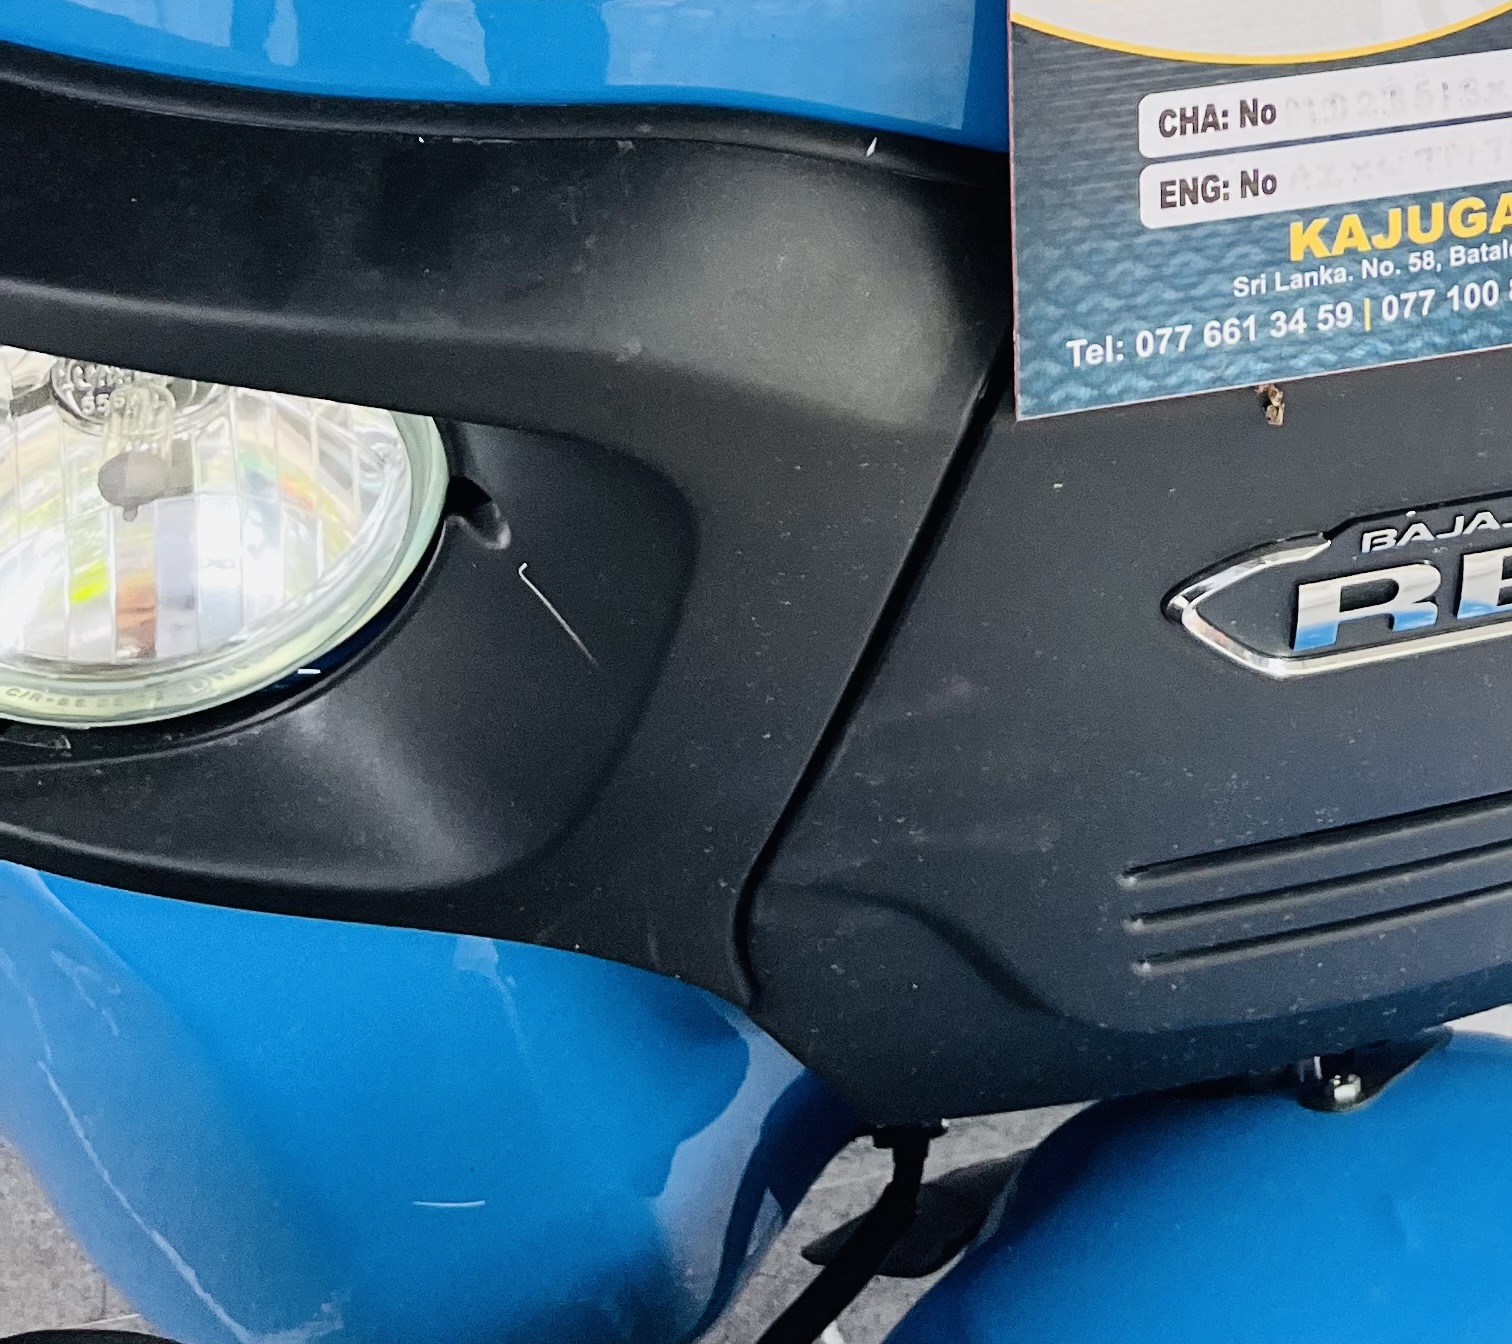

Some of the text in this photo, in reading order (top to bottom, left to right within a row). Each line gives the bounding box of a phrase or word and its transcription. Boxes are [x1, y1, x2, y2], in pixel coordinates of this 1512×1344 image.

[1158, 98, 1277, 138] CHA: No
[1160, 168, 1278, 209] ENG: No
[1232, 273, 1267, 299] Sri
[1274, 263, 1354, 293] Lanka.
[1361, 257, 1402, 281] No.
[1408, 249, 1443, 273] 58,
[1065, 334, 1125, 368] Tel:
[1135, 323, 1193, 358] 077
[1202, 314, 1257, 348] 661
[1269, 310, 1308, 339] 34
[1316, 301, 1354, 332] 59
[1381, 288, 1436, 322] 077
[1446, 279, 1500, 312] 100
